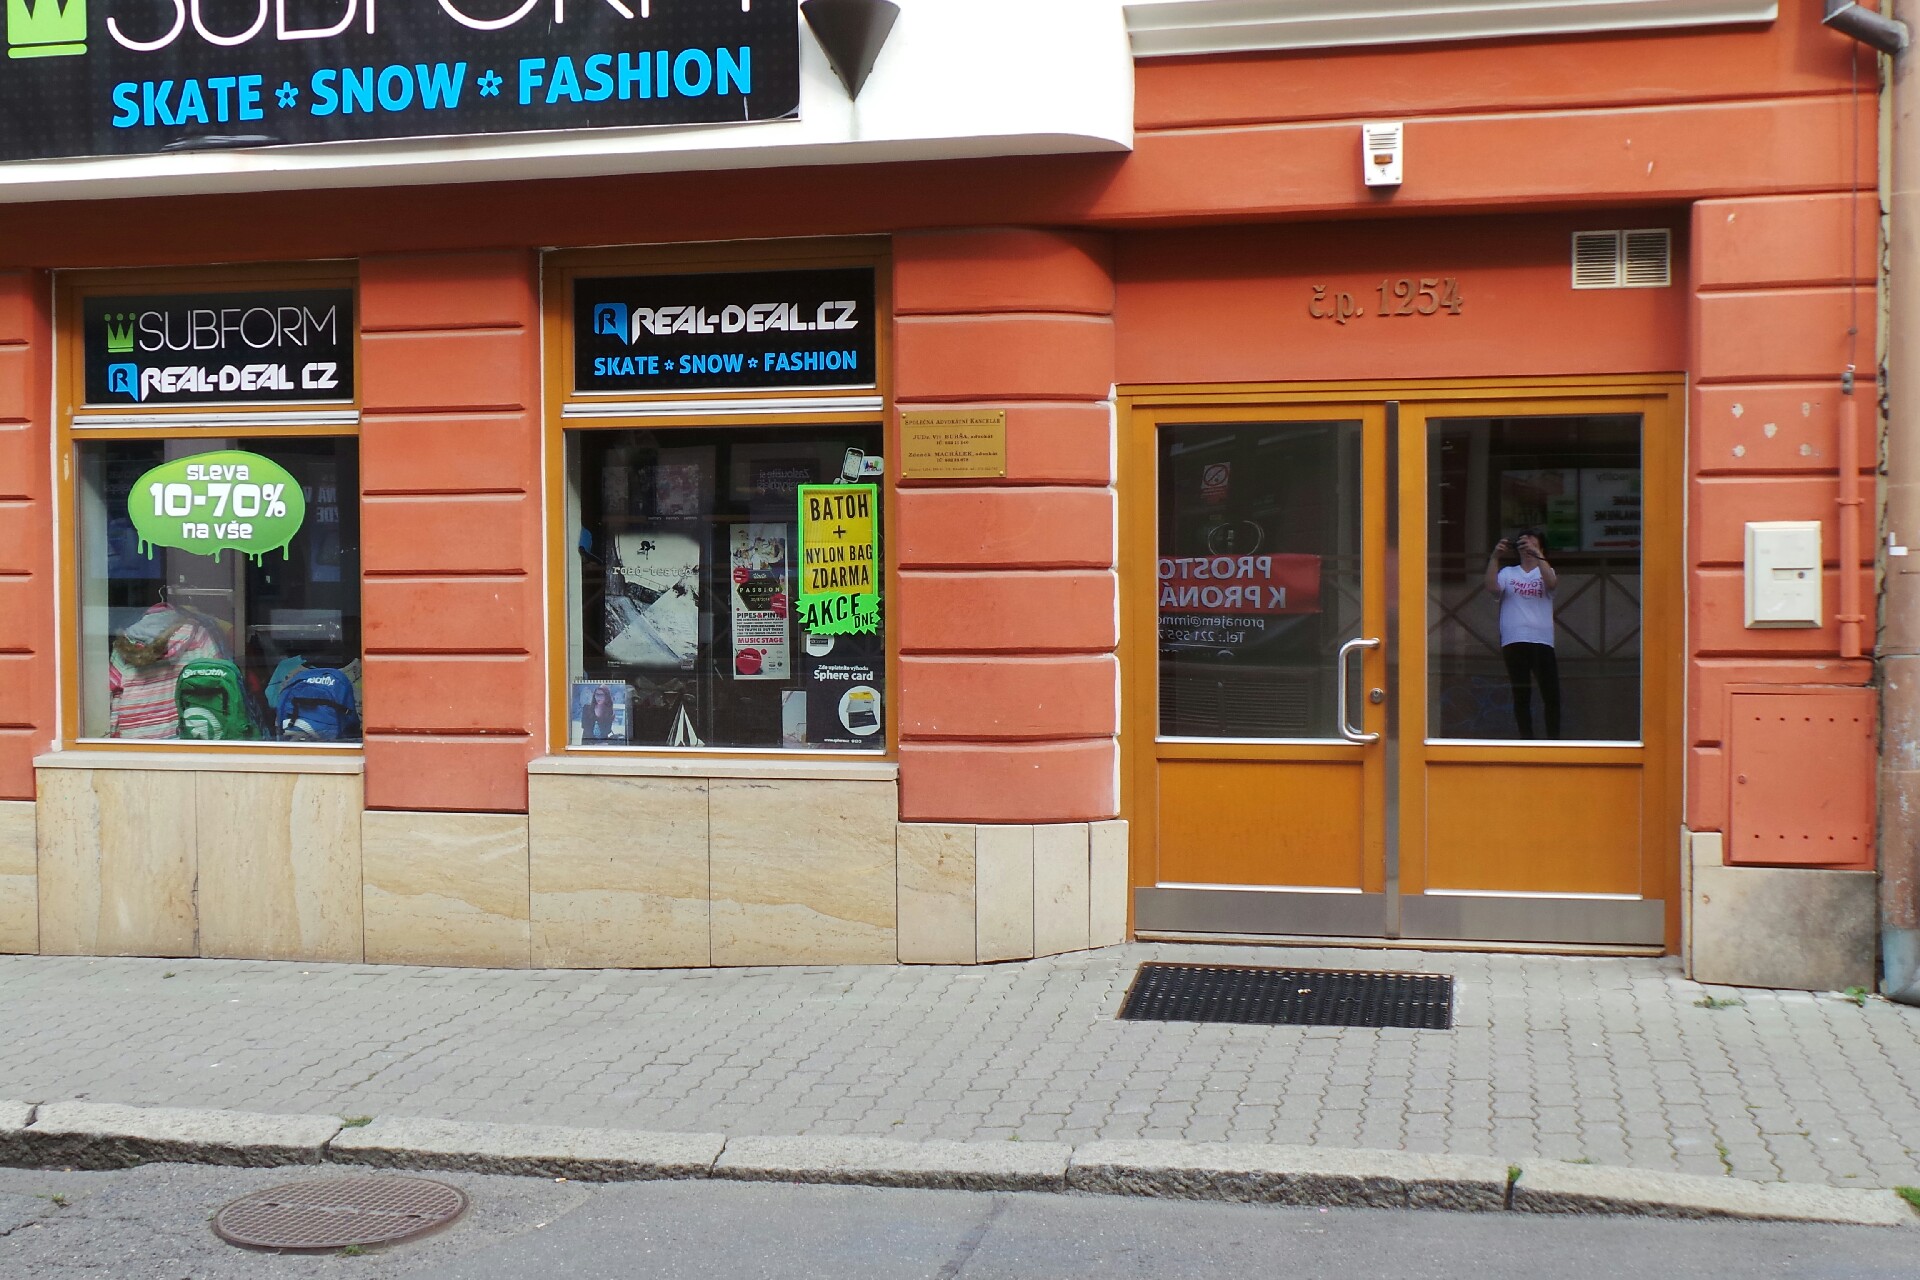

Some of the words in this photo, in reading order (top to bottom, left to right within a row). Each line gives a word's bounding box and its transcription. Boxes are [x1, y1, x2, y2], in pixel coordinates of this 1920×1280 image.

[112, 74, 264, 128] SKATE
[310, 61, 467, 116] SNOW
[519, 46, 751, 105] FASHION
[1309, 284, 1364, 325] č.p.
[1376, 277, 1464, 317] 1254
[139, 305, 337, 351] SUBFORM
[632, 300, 859, 345] REAL-DEAL.CZ
[593, 355, 659, 376] SKATE
[679, 353, 744, 374] SNOW
[764, 350, 857, 372] FASHION
[140, 363, 295, 402] REAL-DEAL
[150, 482, 286, 518] 10-70%
[809, 493, 869, 521] BATOH
[806, 546, 844, 564] NYLON
[849, 543, 873, 561] BAG
[812, 564, 869, 589] ZDARMA
[806, 592, 861, 629] AKCE
[813, 669, 850, 682] Sphere
[851, 670, 874, 681] card
